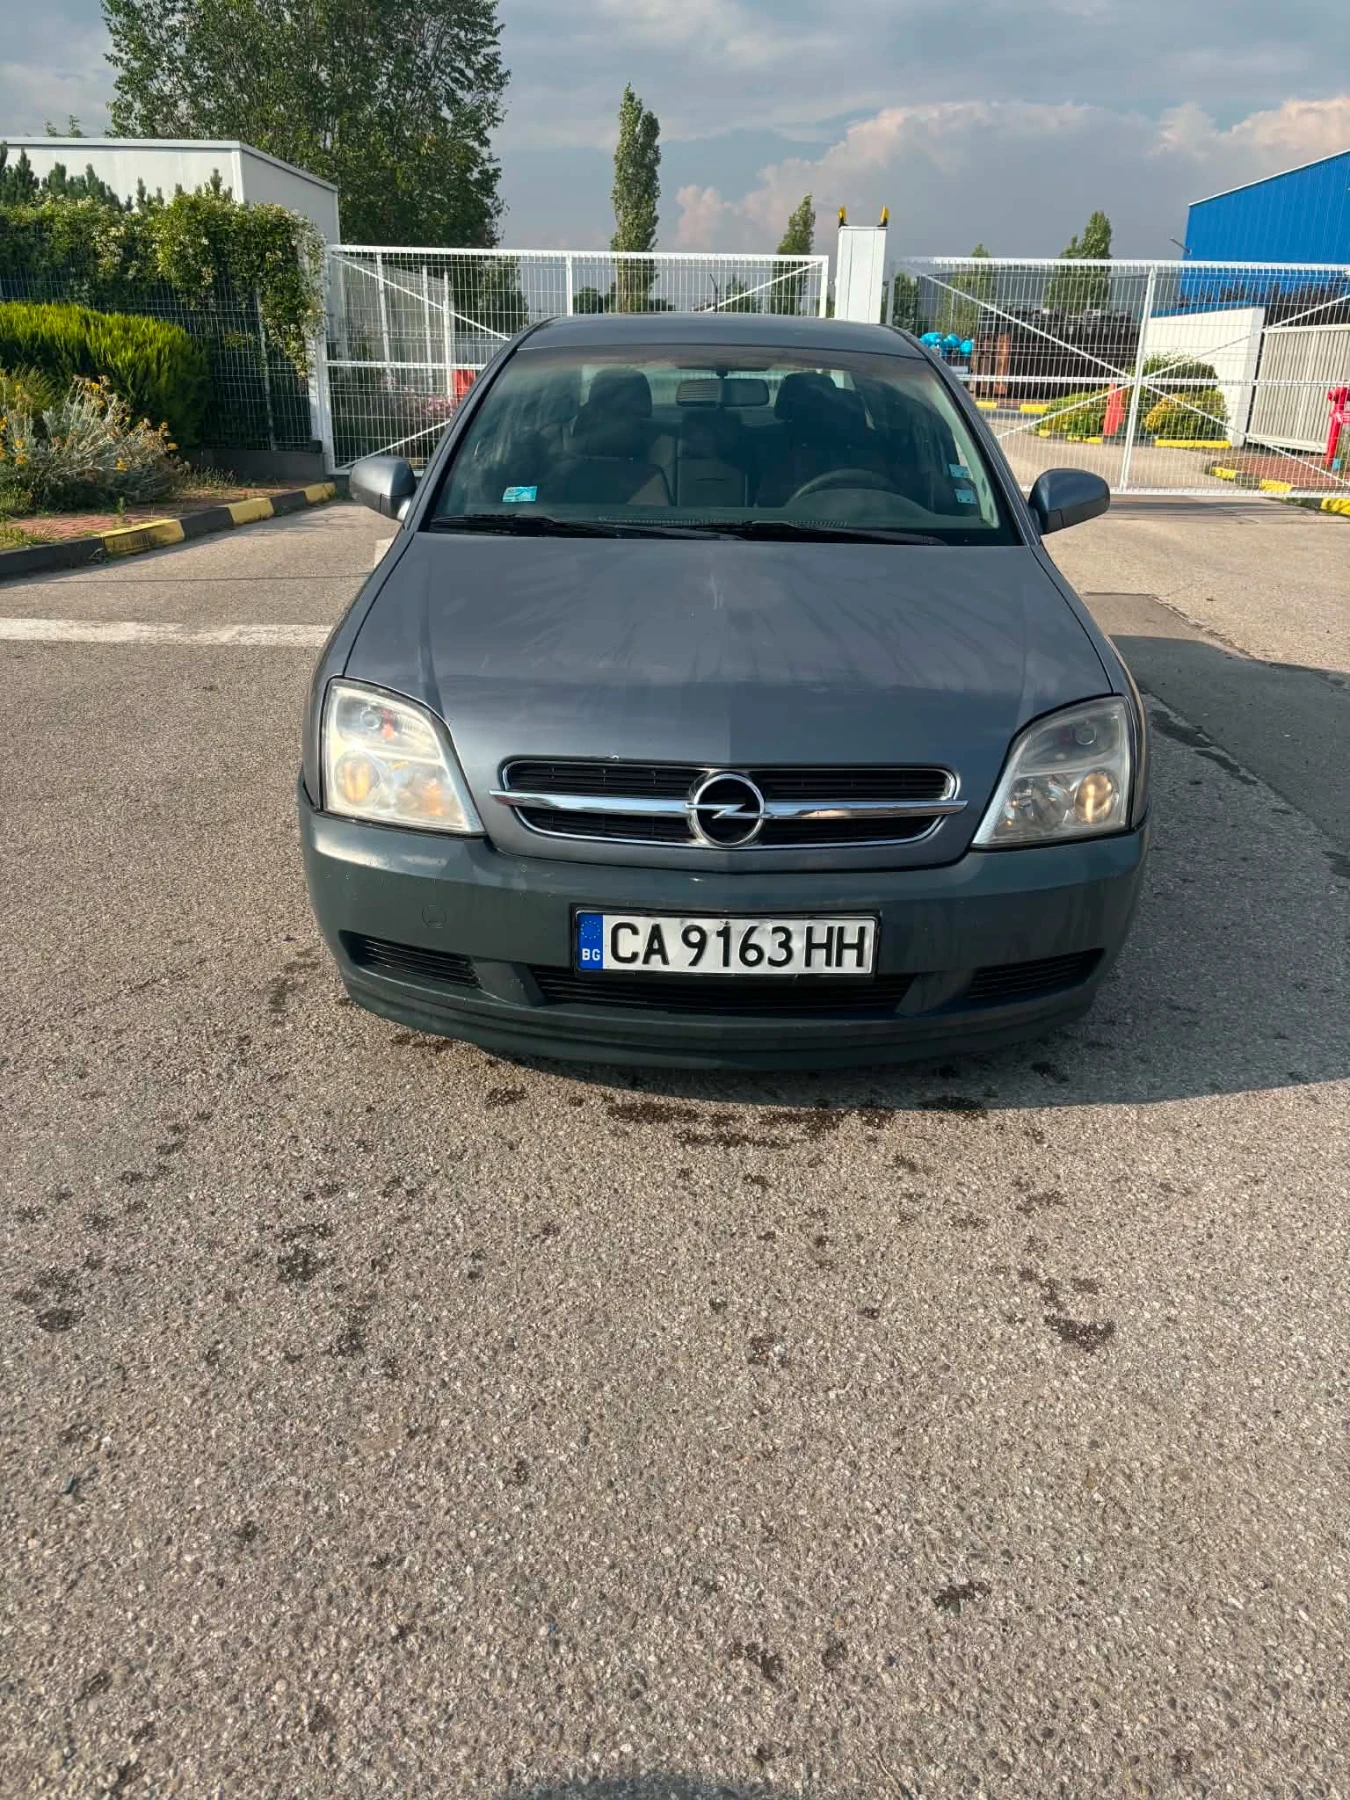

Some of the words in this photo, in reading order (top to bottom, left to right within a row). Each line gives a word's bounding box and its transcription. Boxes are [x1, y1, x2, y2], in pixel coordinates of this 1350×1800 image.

[581, 948, 600, 961] BG
[610, 922, 669, 965] CA
[681, 924, 794, 967] 9163
[804, 926, 866, 968] HH
